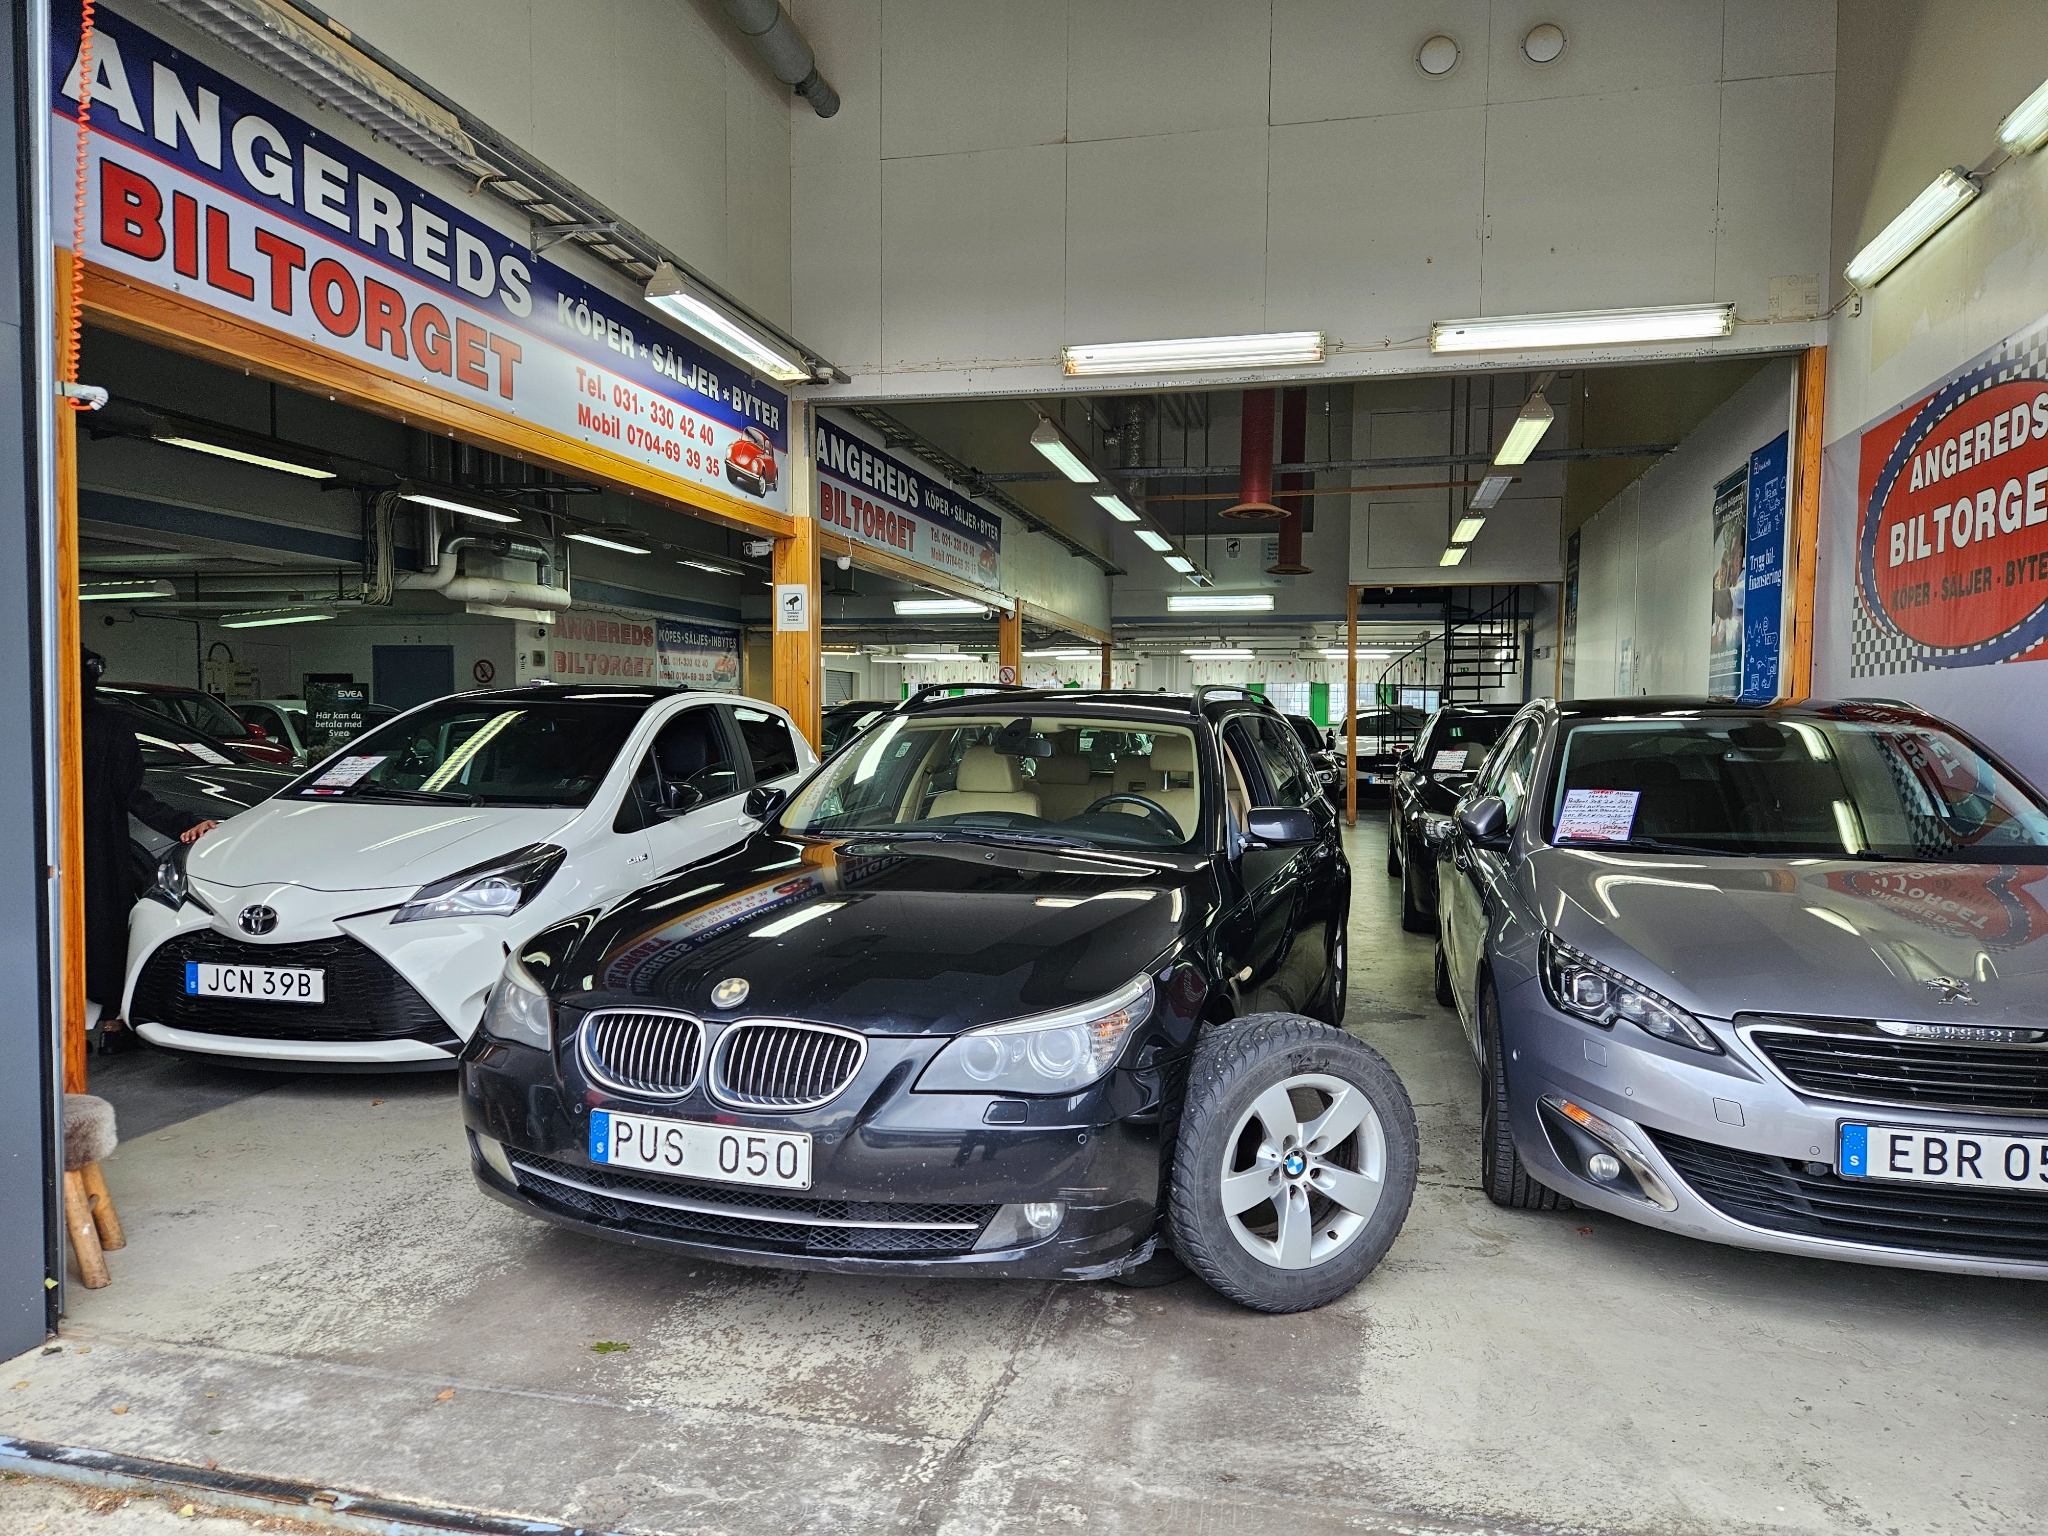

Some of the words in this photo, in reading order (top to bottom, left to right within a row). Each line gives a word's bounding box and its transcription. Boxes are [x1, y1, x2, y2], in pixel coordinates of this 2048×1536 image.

[61, 26, 533, 318] ANGEREDS
[100, 157, 522, 400] BILTORGET
[556, 291, 635, 360] KÖPER
[652, 342, 720, 402] SÄLJER
[732, 385, 779, 432] BYTER
[576, 366, 606, 402] Tel.
[613, 384, 644, 416] 031-
[650, 400, 674, 430] 330
[679, 414, 694, 439] 42
[699, 423, 714, 447] 40
[577, 403, 620, 440] Mobil
[627, 424, 680, 462] 0704-69
[686, 448, 700, 470] 39
[705, 455, 720, 477] 35
[1908, 390, 2048, 494] ANGEREDS
[816, 426, 919, 509] ANGEREDS
[820, 480, 916, 552] BILTORGET
[925, 489, 949, 517] KÖPER
[954, 505, 976, 531] SÄLJER
[980, 519, 998, 541] BYTER
[1748, 568, 1781, 591] finansiering
[1750, 554, 1765, 573] Trygg
[553, 616, 654, 647] ANGEREDS
[554, 651, 654, 677] BILTORGET
[315, 711, 331, 719] Här
[333, 711, 349, 719] kan
[351, 711, 361, 719] du
[315, 720, 342, 728] betala
[344, 720, 362, 728] med
[208, 968, 252, 994] JCN
[263, 971, 311, 997] 39B
[1915, 1024, 2016, 1038] PEUGEOT
[615, 1120, 683, 1166] PUS
[719, 1135, 798, 1179] 050
[1889, 1134, 1983, 1179] EBR
